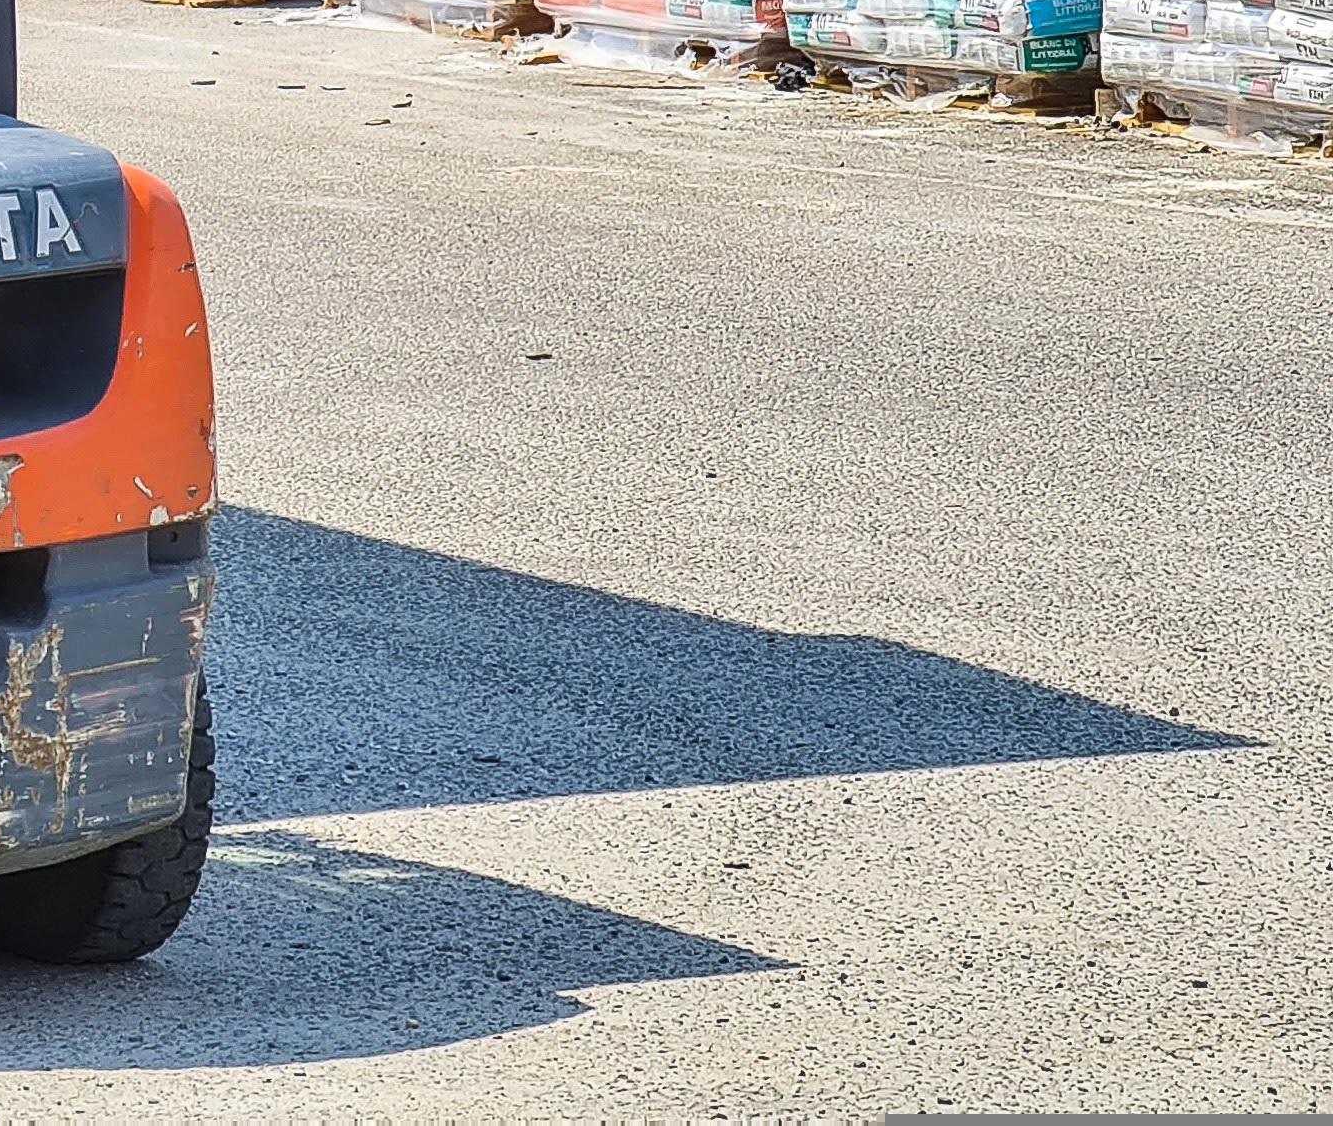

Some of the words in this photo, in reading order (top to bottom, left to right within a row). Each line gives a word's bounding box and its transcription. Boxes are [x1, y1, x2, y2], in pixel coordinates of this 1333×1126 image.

[1029, 39, 1061, 50] BLANC
[1064, 37, 1076, 47] DU
[1032, 47, 1077, 59] LITTORAL
